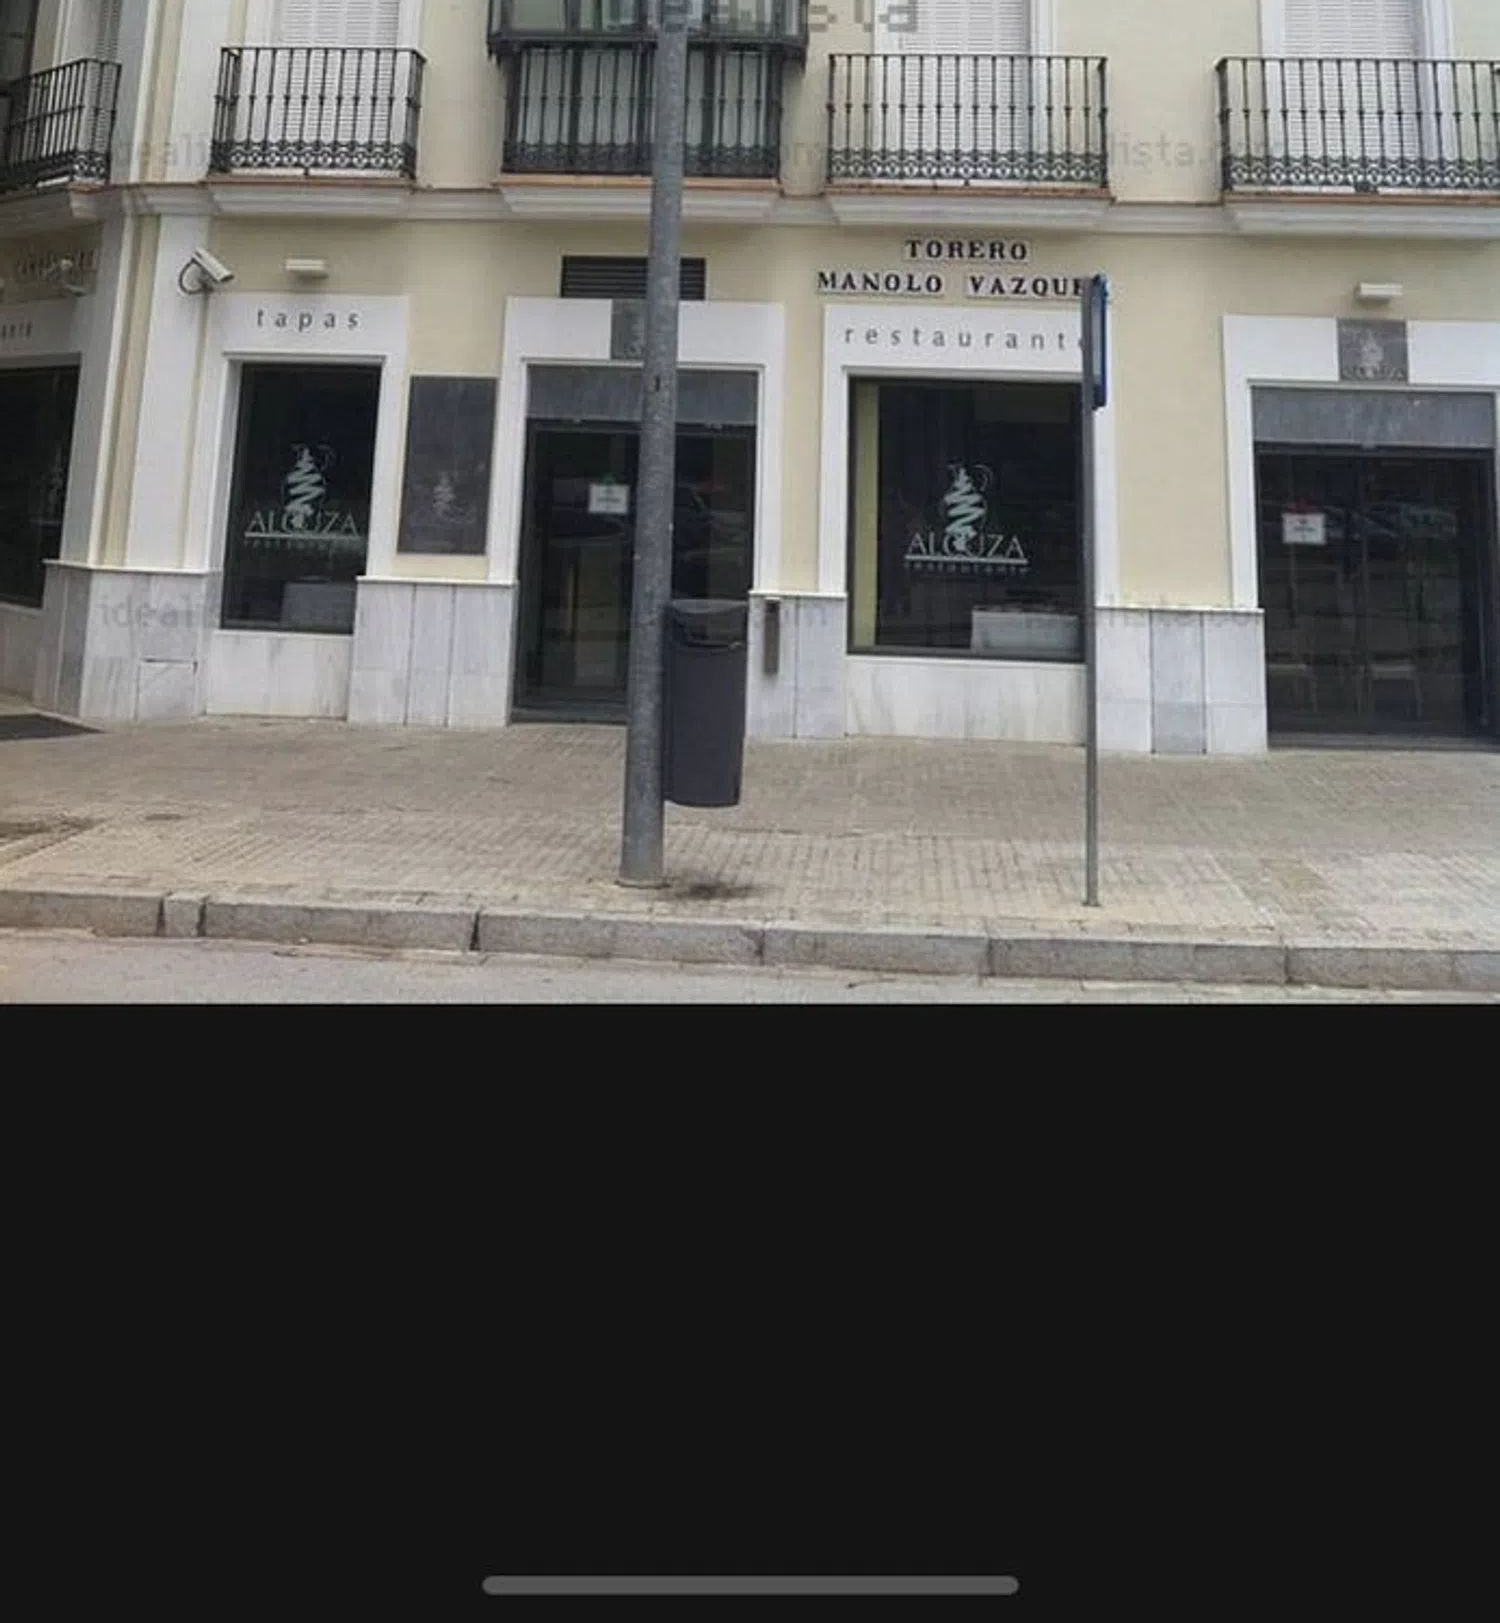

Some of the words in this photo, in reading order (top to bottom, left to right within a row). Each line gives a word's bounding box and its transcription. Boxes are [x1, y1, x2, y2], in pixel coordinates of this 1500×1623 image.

[905, 240, 1027, 260] TORERO
[817, 272, 943, 293] MANOLO
[969, 275, 1083, 296] VAZQUE
[257, 309, 359, 332] tapas
[844, 327, 1084, 351] restaurant
